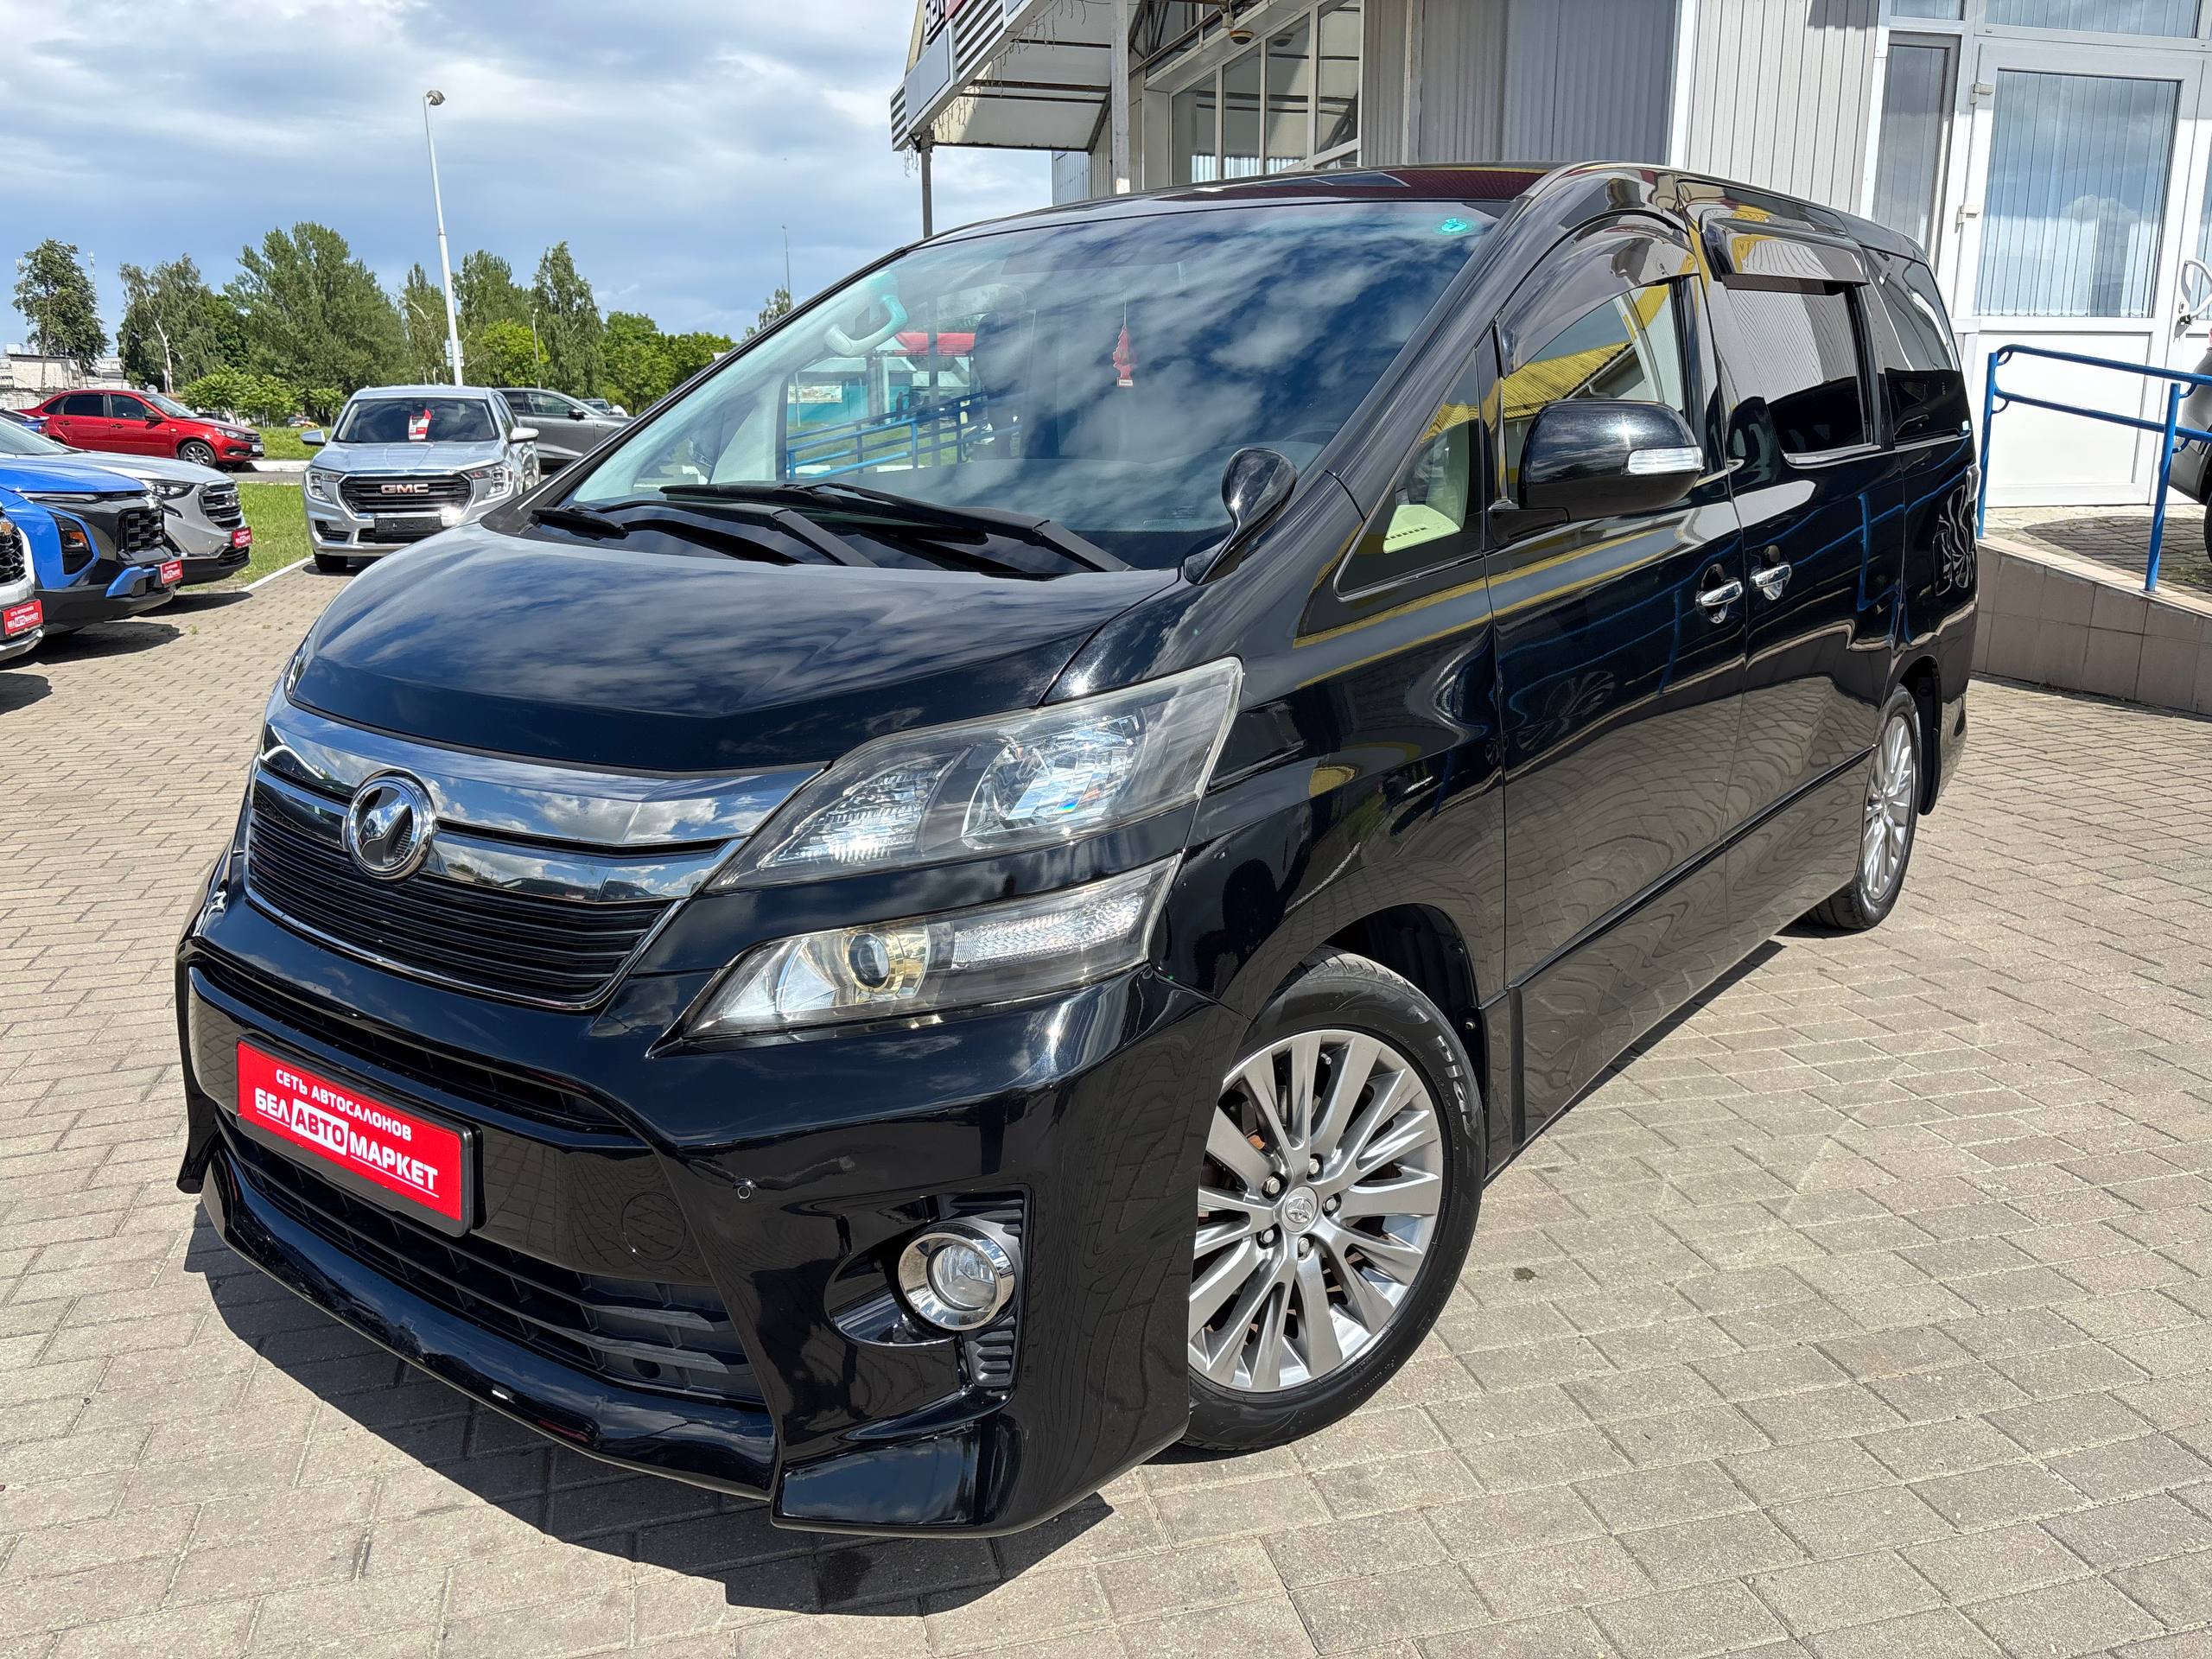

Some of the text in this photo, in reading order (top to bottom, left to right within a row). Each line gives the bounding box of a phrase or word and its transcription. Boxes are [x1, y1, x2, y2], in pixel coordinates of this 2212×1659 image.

[381, 484, 429, 493] GMC
[276, 1069, 412, 1141] СЕТЬ АВТОСАЛОНОВ
